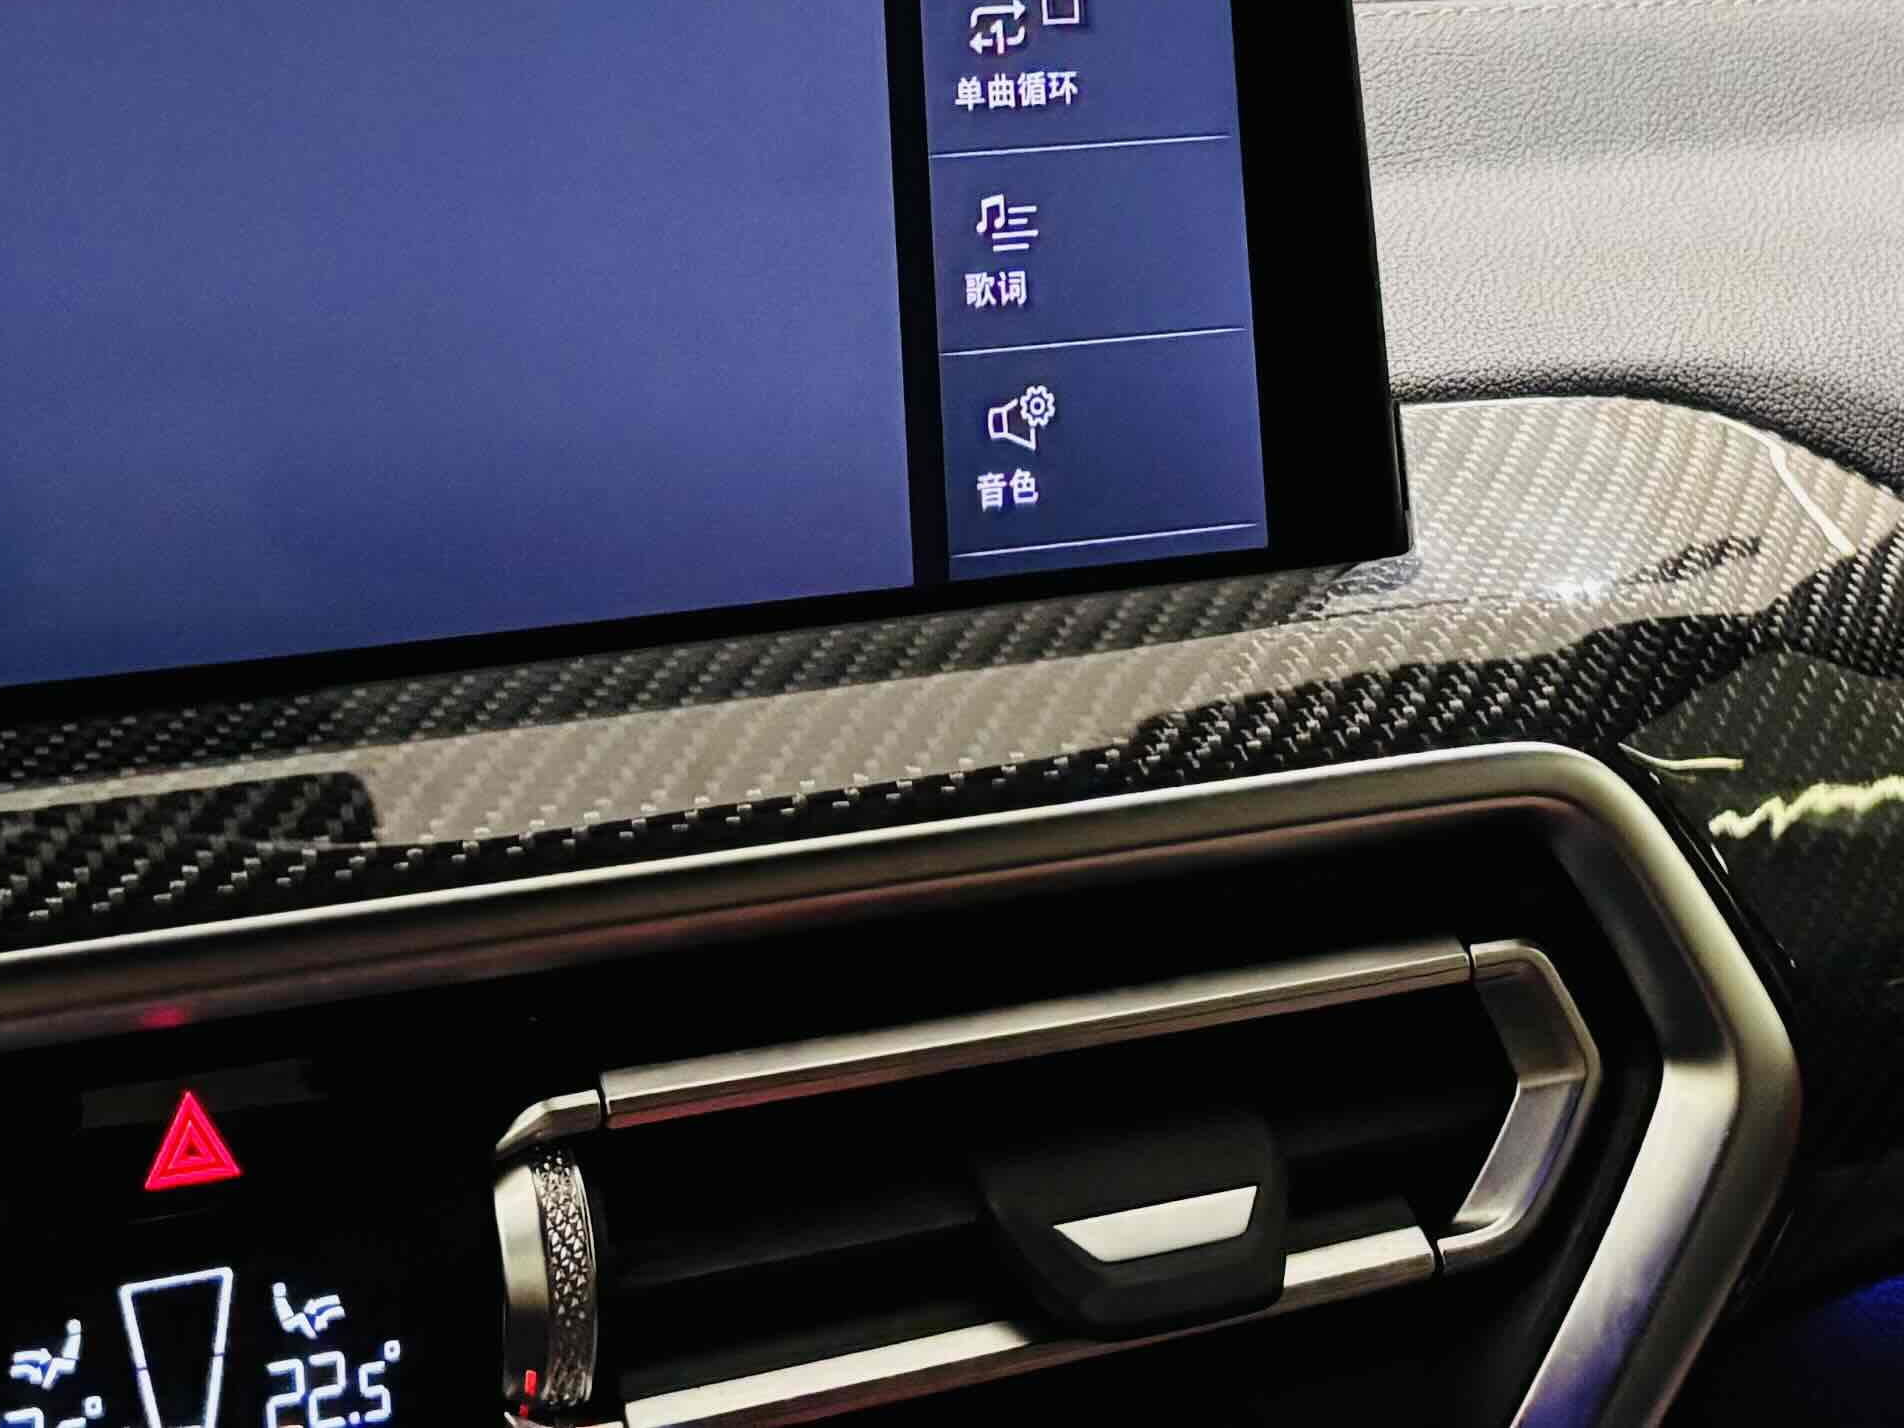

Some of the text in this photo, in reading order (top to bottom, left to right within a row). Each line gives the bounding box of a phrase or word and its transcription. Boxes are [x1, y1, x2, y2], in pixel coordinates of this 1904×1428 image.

[954, 71, 1079, 111] 单曲循环
[964, 270, 1028, 308] 歌词
[976, 469, 1039, 511] 音色
